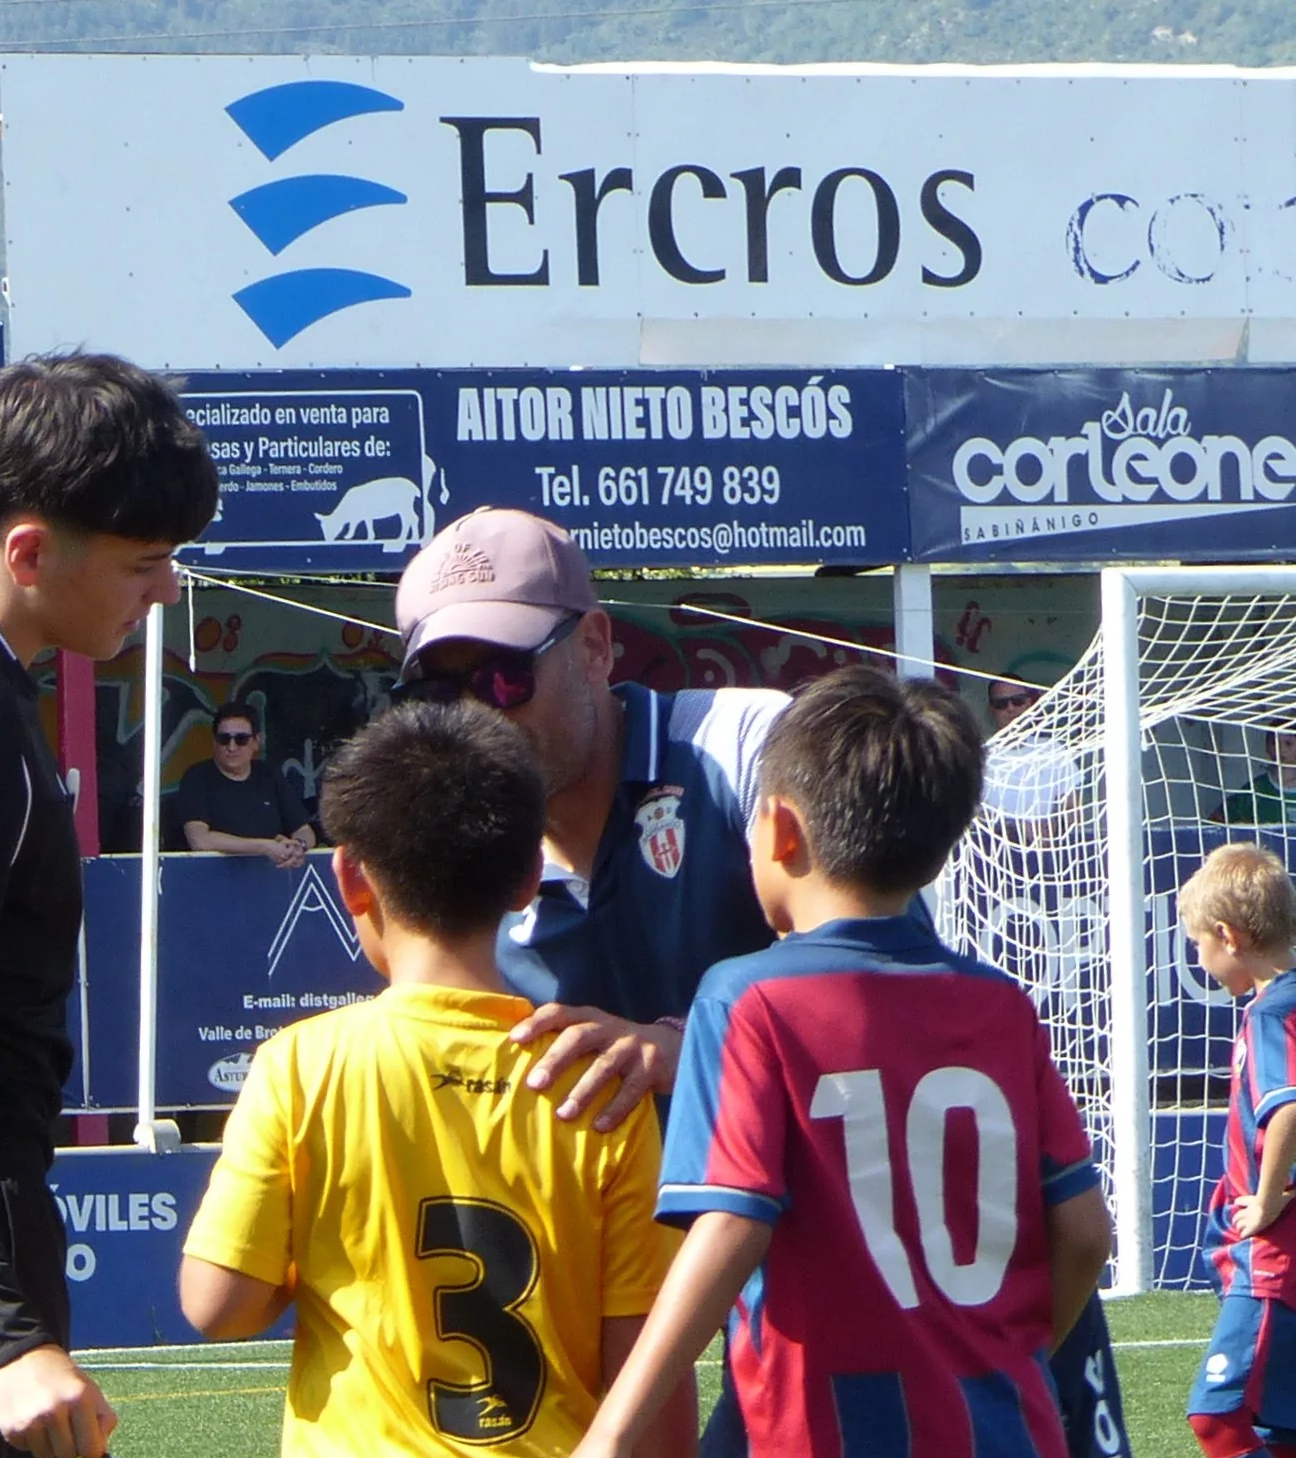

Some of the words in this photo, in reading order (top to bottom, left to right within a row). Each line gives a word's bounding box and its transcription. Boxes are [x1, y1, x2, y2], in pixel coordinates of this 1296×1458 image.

[440, 116, 983, 288] Ercros
[1066, 193, 1296, 284] co
[275, 409, 296, 425] en
[300, 406, 347, 425] venta
[352, 406, 390, 428] para
[457, 387, 573, 441] AITOR
[582, 386, 693, 440] NIETO
[702, 376, 853, 440] BESCÓS
[1102, 388, 1191, 440] Sala
[206, 440, 240, 460] sas
[244, 440, 254, 463] y
[259, 434, 361, 459] Particulares
[364, 434, 391, 457] de:
[952, 421, 1296, 503] corleone
[229, 463, 262, 478] Gallega
[269, 463, 302, 475] Ternera
[308, 462, 343, 475] Cordero
[245, 480, 284, 493] Jamones
[291, 479, 337, 492] Embutidos
[535, 465, 589, 506] Tel.
[598, 467, 648, 505] 661
[657, 466, 712, 504] 749
[723, 466, 780, 503] 839
[964, 512, 1099, 541] SABIÑÁNIGO
[243, 993, 296, 1009] E-mail:
[198, 1026, 232, 1041] Valle
[235, 1026, 252, 1040] de
[50, 1184, 177, 1232] VILES
[809, 1066, 1019, 1309] 10
[416, 1195, 547, 1446] 3
